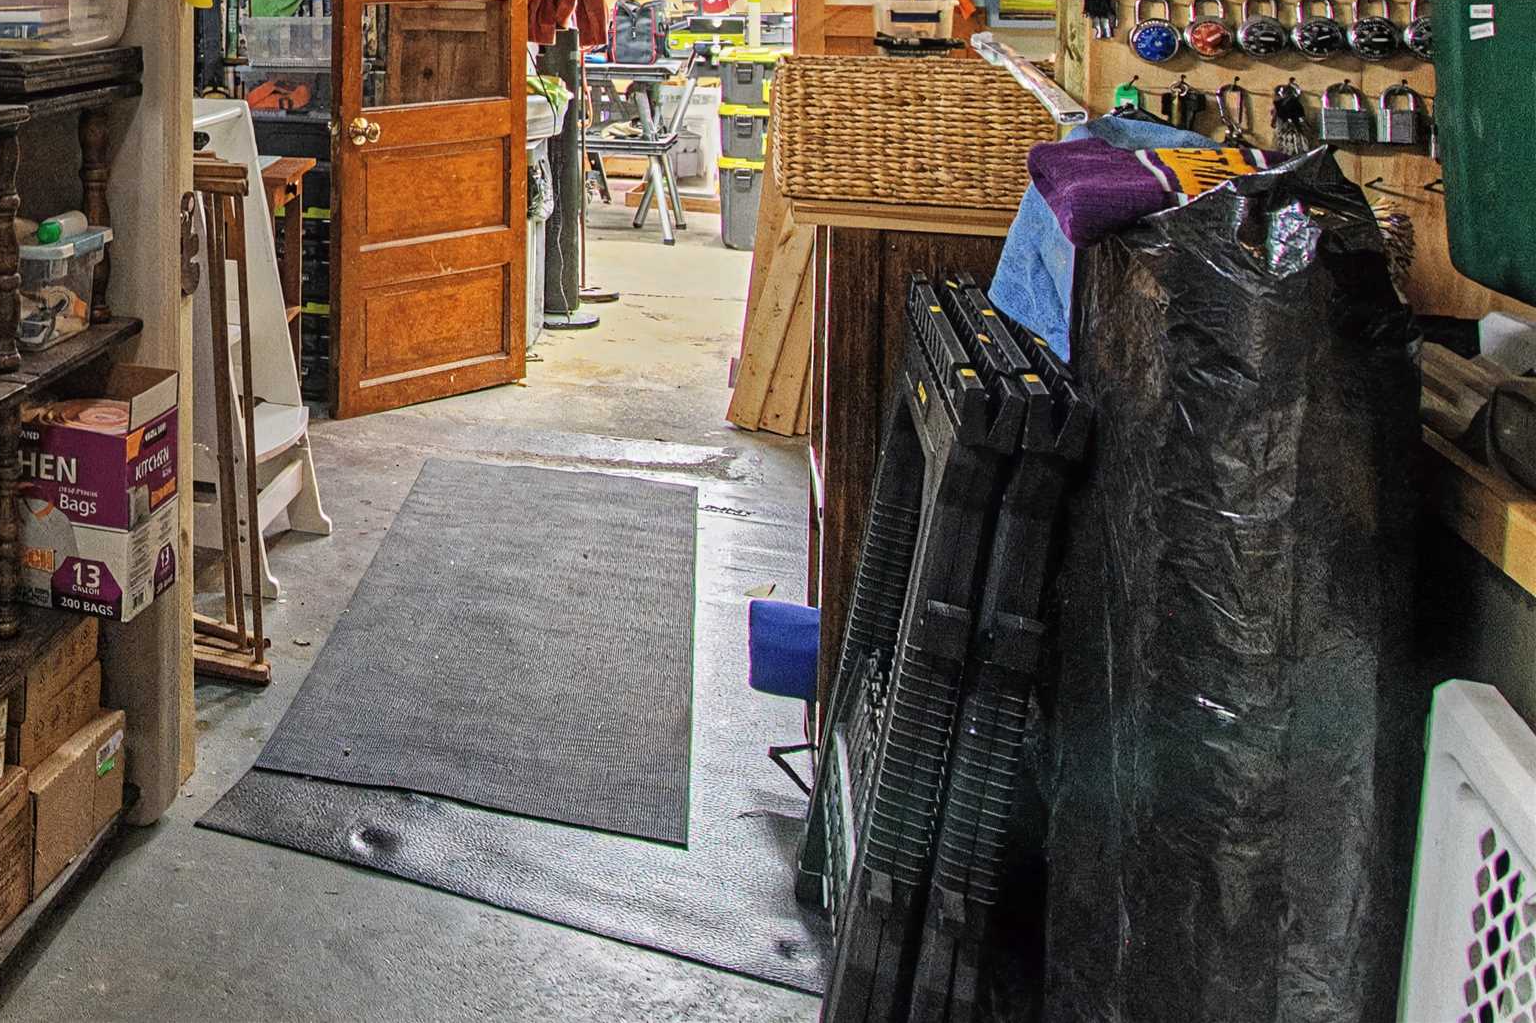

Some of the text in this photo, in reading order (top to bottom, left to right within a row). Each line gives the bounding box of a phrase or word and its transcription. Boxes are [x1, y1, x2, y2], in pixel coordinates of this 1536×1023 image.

[135, 445, 170, 481] KITCHEN
[59, 494, 97, 516] Bags
[72, 561, 101, 588] 13
[61, 596, 114, 617] 200 BAGS
